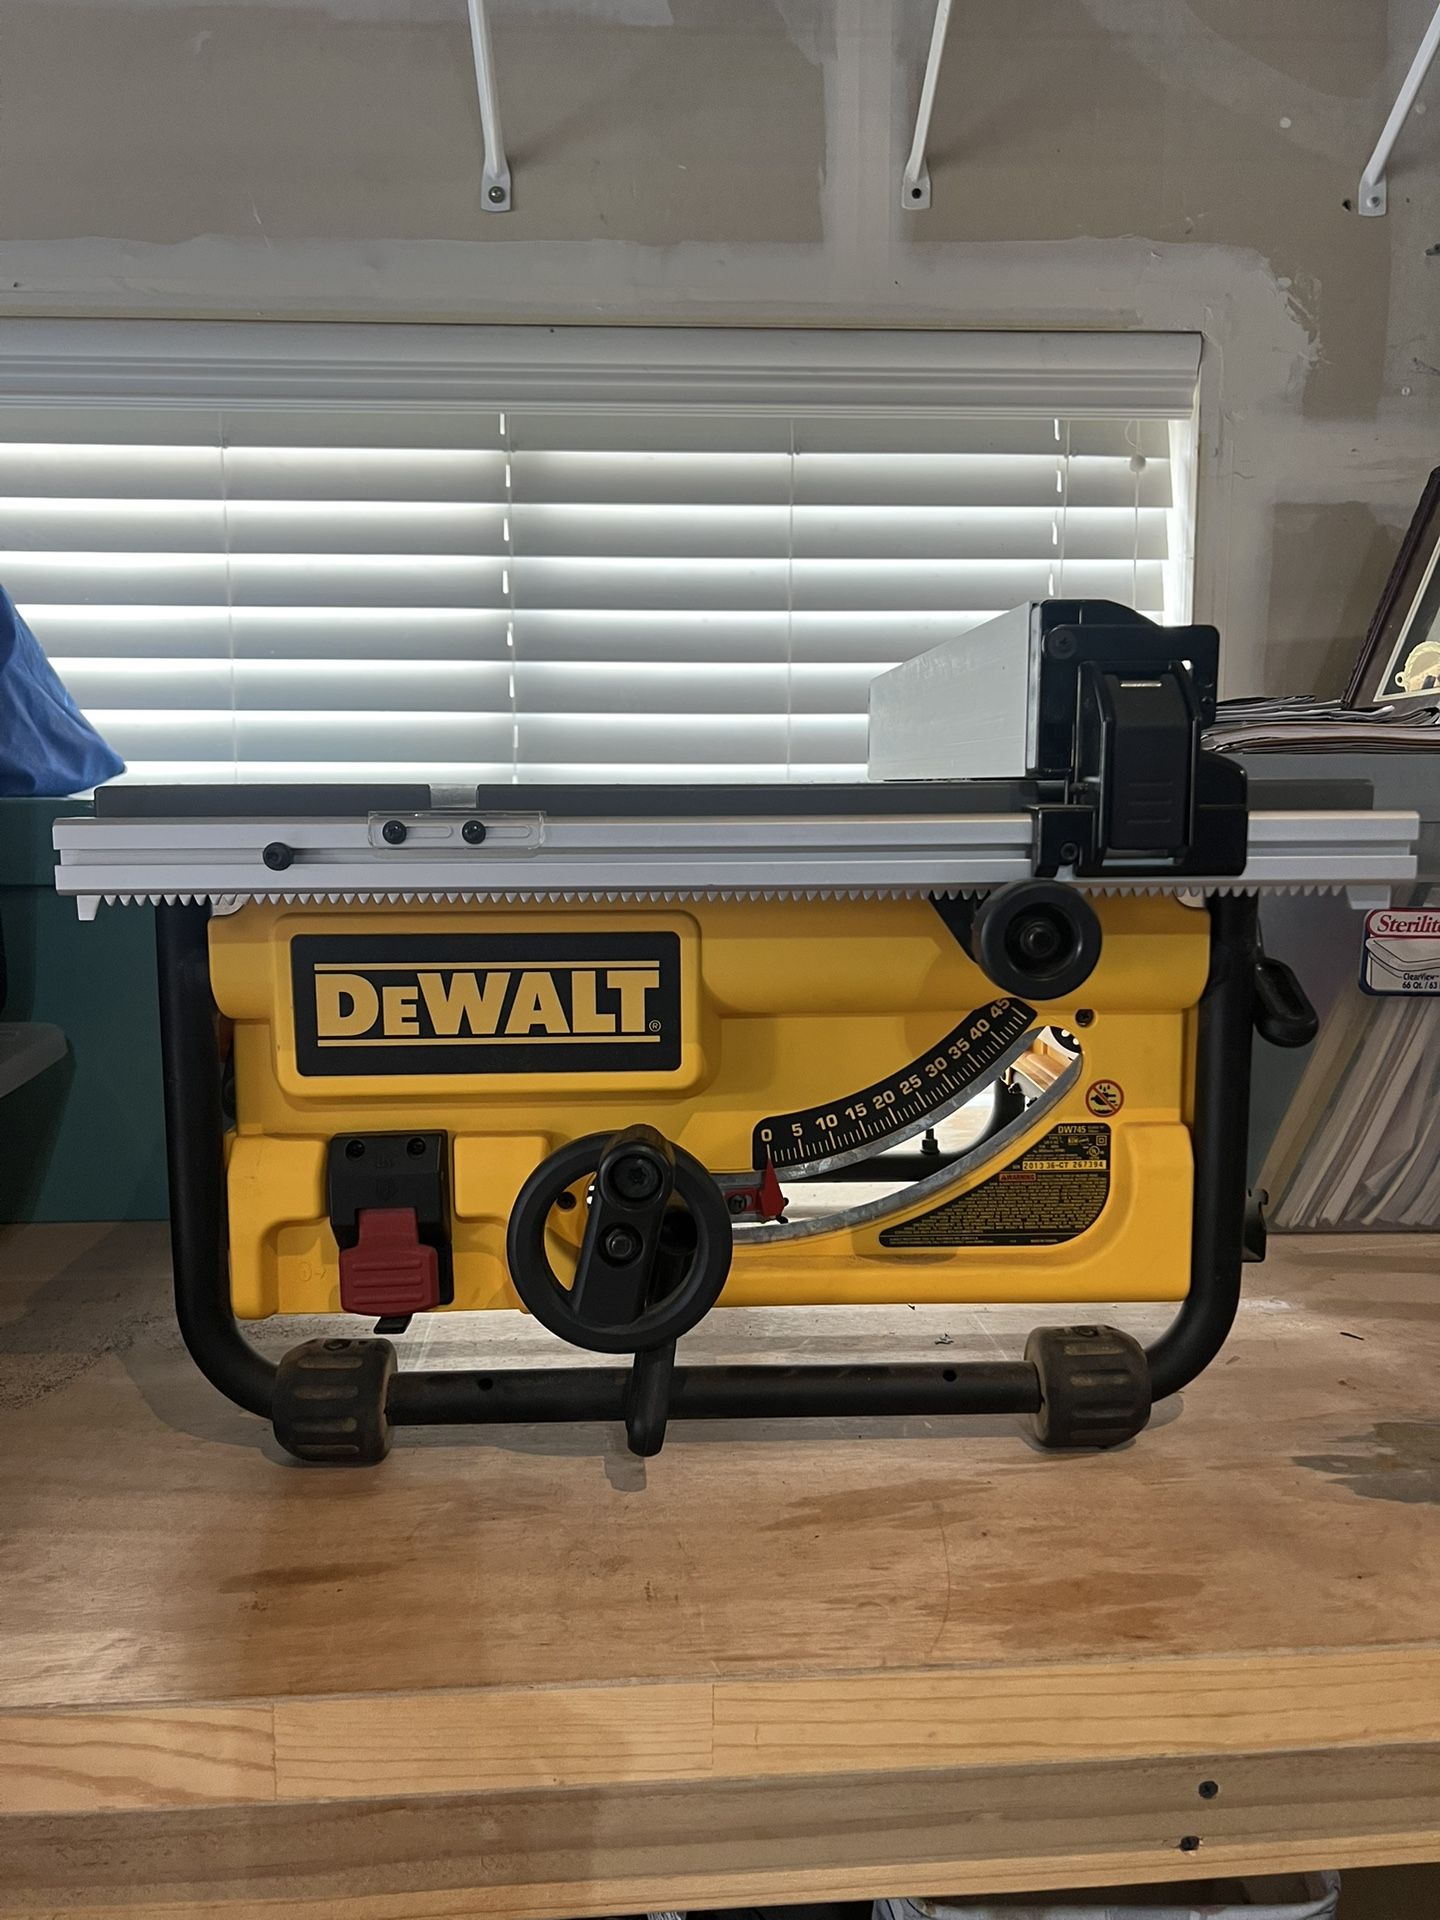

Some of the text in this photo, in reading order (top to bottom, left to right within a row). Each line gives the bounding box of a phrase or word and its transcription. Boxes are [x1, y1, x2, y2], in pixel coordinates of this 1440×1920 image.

[761, 999, 1010, 1142] 0 5 10 15 20 25 30 35 40 45
